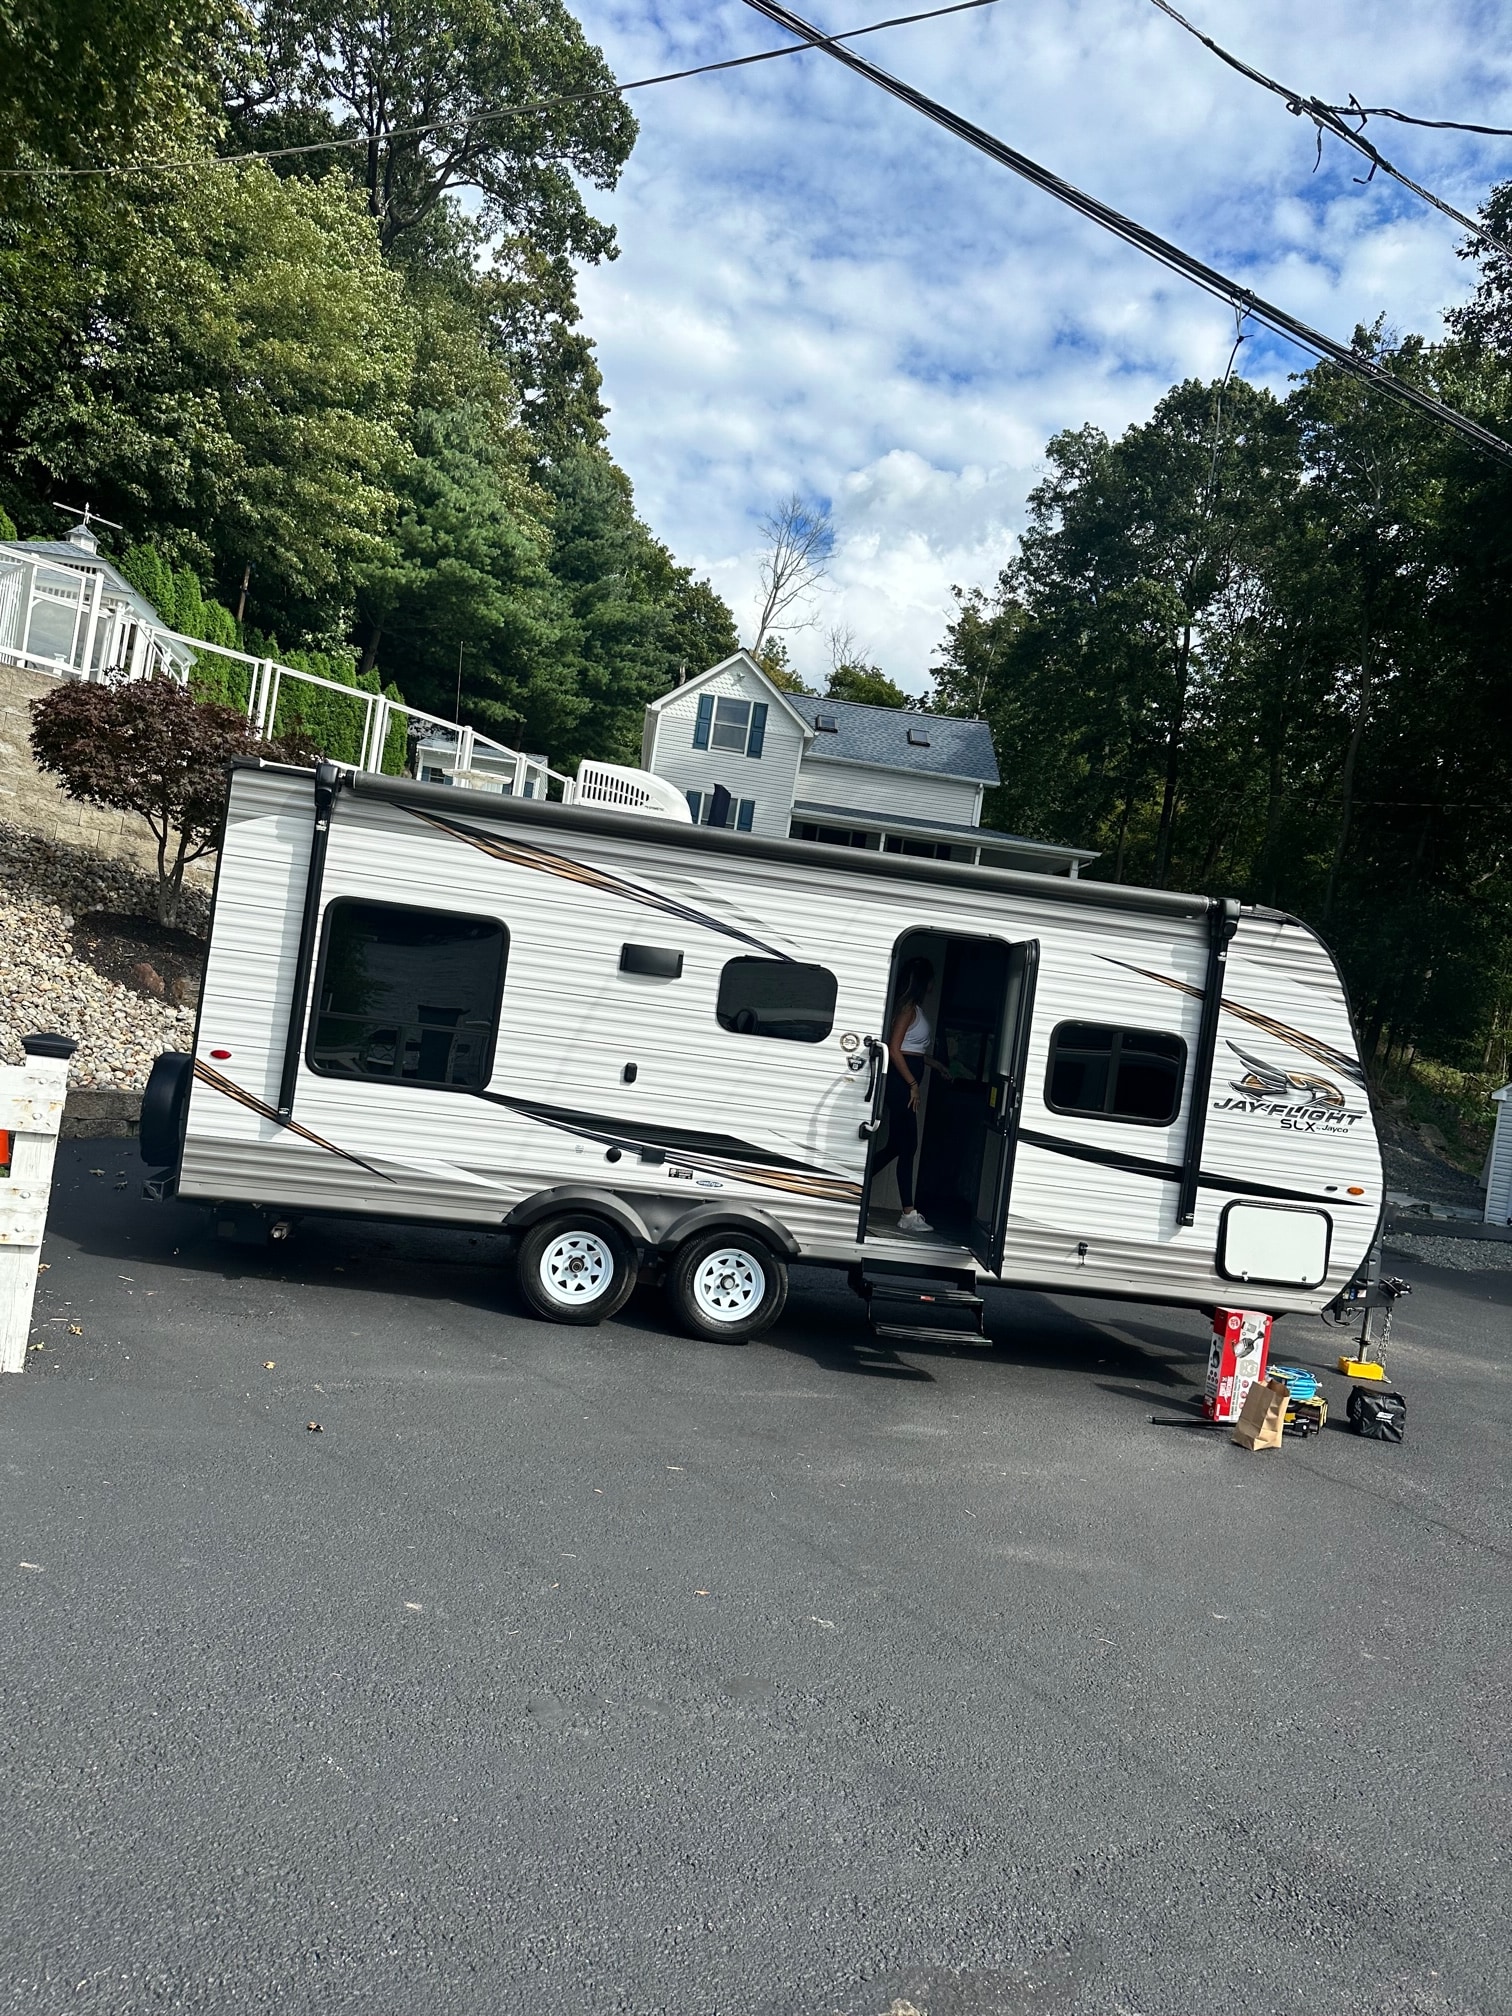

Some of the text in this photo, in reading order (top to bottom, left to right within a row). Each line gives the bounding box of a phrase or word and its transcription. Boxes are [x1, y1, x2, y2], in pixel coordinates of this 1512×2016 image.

[1213, 1098, 1363, 1125] JAY FLIGHT
[1280, 1118, 1316, 1132] SLX
[1321, 1124, 1349, 1134] Jayco
